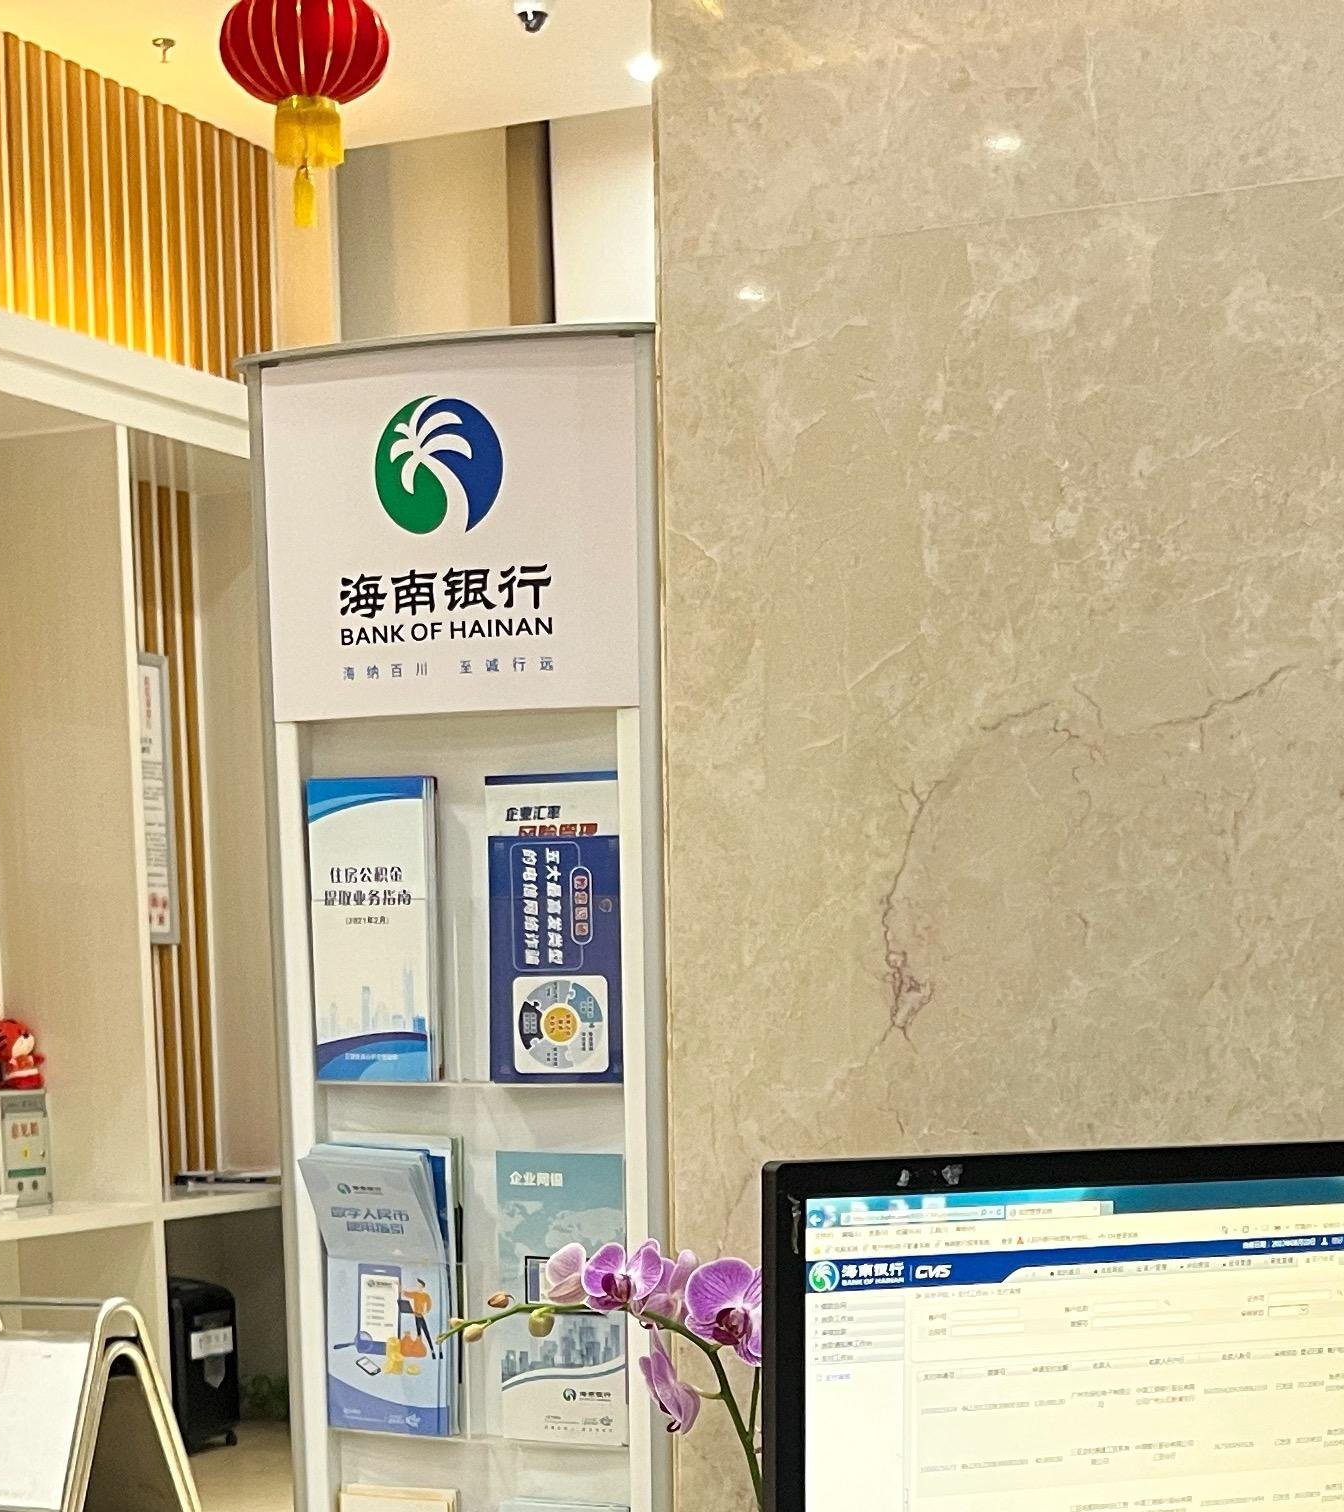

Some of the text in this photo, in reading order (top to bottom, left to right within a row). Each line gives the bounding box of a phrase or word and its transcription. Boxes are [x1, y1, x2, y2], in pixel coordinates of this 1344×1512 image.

[340, 563, 552, 618] 海南银行
[341, 617, 554, 646] BANK OF HAINAN
[343, 656, 554, 680] 海纳百川 至诚行远
[329, 865, 403, 883] 住房公积金
[324, 889, 412, 907] 提取业务指南
[521, 847, 540, 966] 的电信网络诈骗
[545, 847, 564, 965] 五大最高发类型
[331, 1206, 410, 1221] 数字人民币
[842, 1262, 904, 1278] 海南银行
